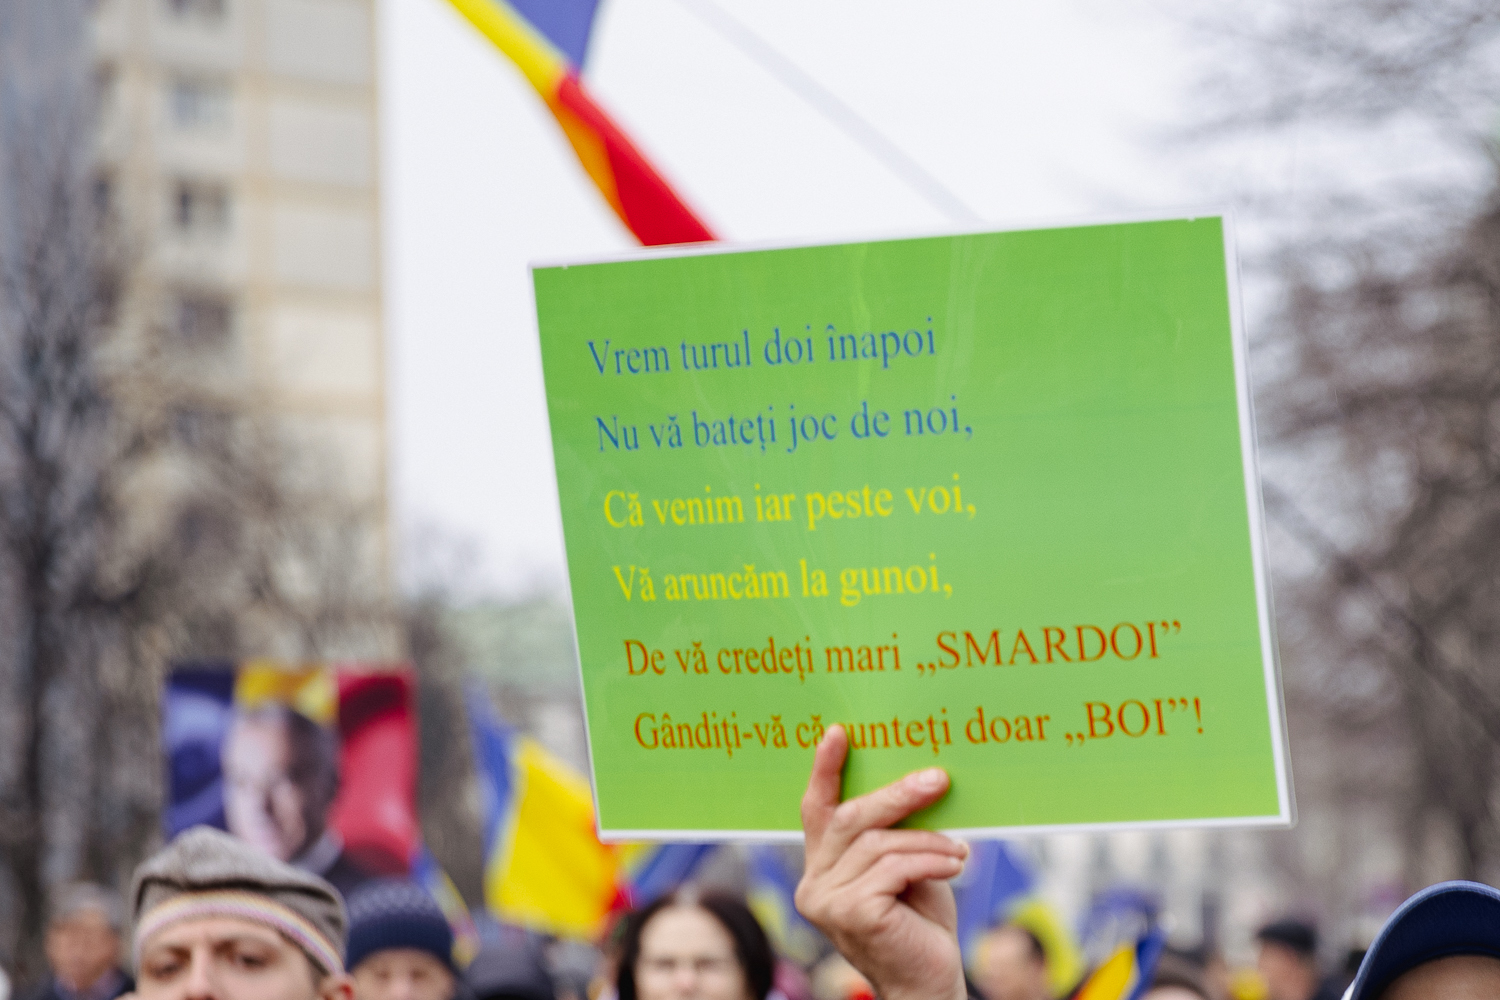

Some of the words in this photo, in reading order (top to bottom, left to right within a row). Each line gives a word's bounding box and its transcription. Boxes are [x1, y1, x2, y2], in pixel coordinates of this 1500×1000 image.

[586, 339, 671, 375] Vrem
[680, 328, 752, 371] turul
[763, 324, 815, 367] doi
[825, 315, 936, 370] înapoi
[595, 414, 640, 452] Nu
[648, 415, 683, 448] vă
[691, 405, 777, 455] bateți
[786, 404, 838, 454] joc
[850, 400, 891, 439] de
[902, 394, 973, 442] noi,
[603, 489, 644, 528] Că
[651, 485, 745, 526] venim
[754, 483, 796, 522] iar
[805, 483, 894, 531] peste
[904, 472, 977, 520] voi,
[611, 565, 656, 602] Vă
[663, 563, 790, 602] aruncăm
[799, 558, 829, 598] la
[839, 552, 953, 608] gunoi,
[624, 639, 667, 676] De
[674, 641, 709, 675] vă
[717, 636, 815, 684] credeți
[825, 632, 901, 674] mari
[634, 711, 789, 759] Gândiți-vă
[796, 714, 825, 750] că
[840, 707, 952, 757] unteți
[965, 706, 1050, 745] doar
